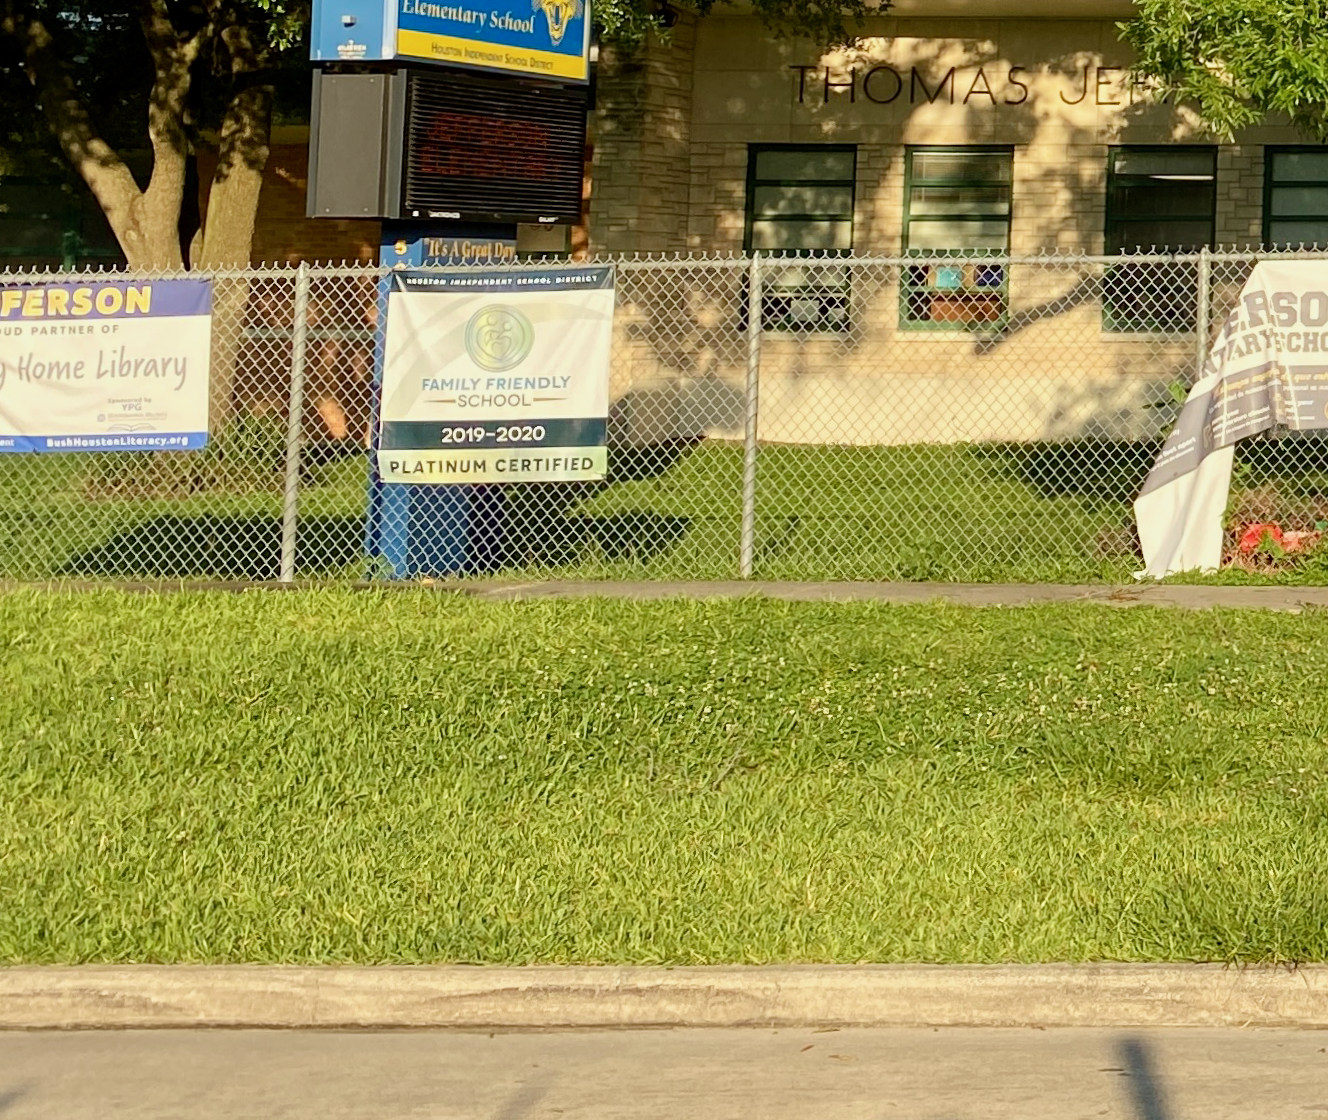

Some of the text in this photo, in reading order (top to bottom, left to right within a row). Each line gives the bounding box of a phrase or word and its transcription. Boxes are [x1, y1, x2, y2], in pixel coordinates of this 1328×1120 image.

[489, 10, 536, 34] School
[789, 66, 1028, 105] THOMAS
[451, 240, 460, 257] A
[461, 240, 492, 259] Great
[494, 242, 516, 262] Day
[406, 275, 598, 286] HOUSTON INDEPENDENT SCHOOL DISTRICT
[31, 325, 94, 336] PARTNER
[101, 324, 120, 334] OF
[18, 352, 85, 383] Home
[96, 345, 187, 391] Library
[421, 376, 571, 392] FAMILY FRIENDLY
[457, 393, 532, 407] SCHOOL
[47, 435, 188, 448] BushHoustonLiteracy.org
[441, 425, 546, 444] 2019-2020
[390, 457, 594, 475] PLATINUM CERTIFIED
